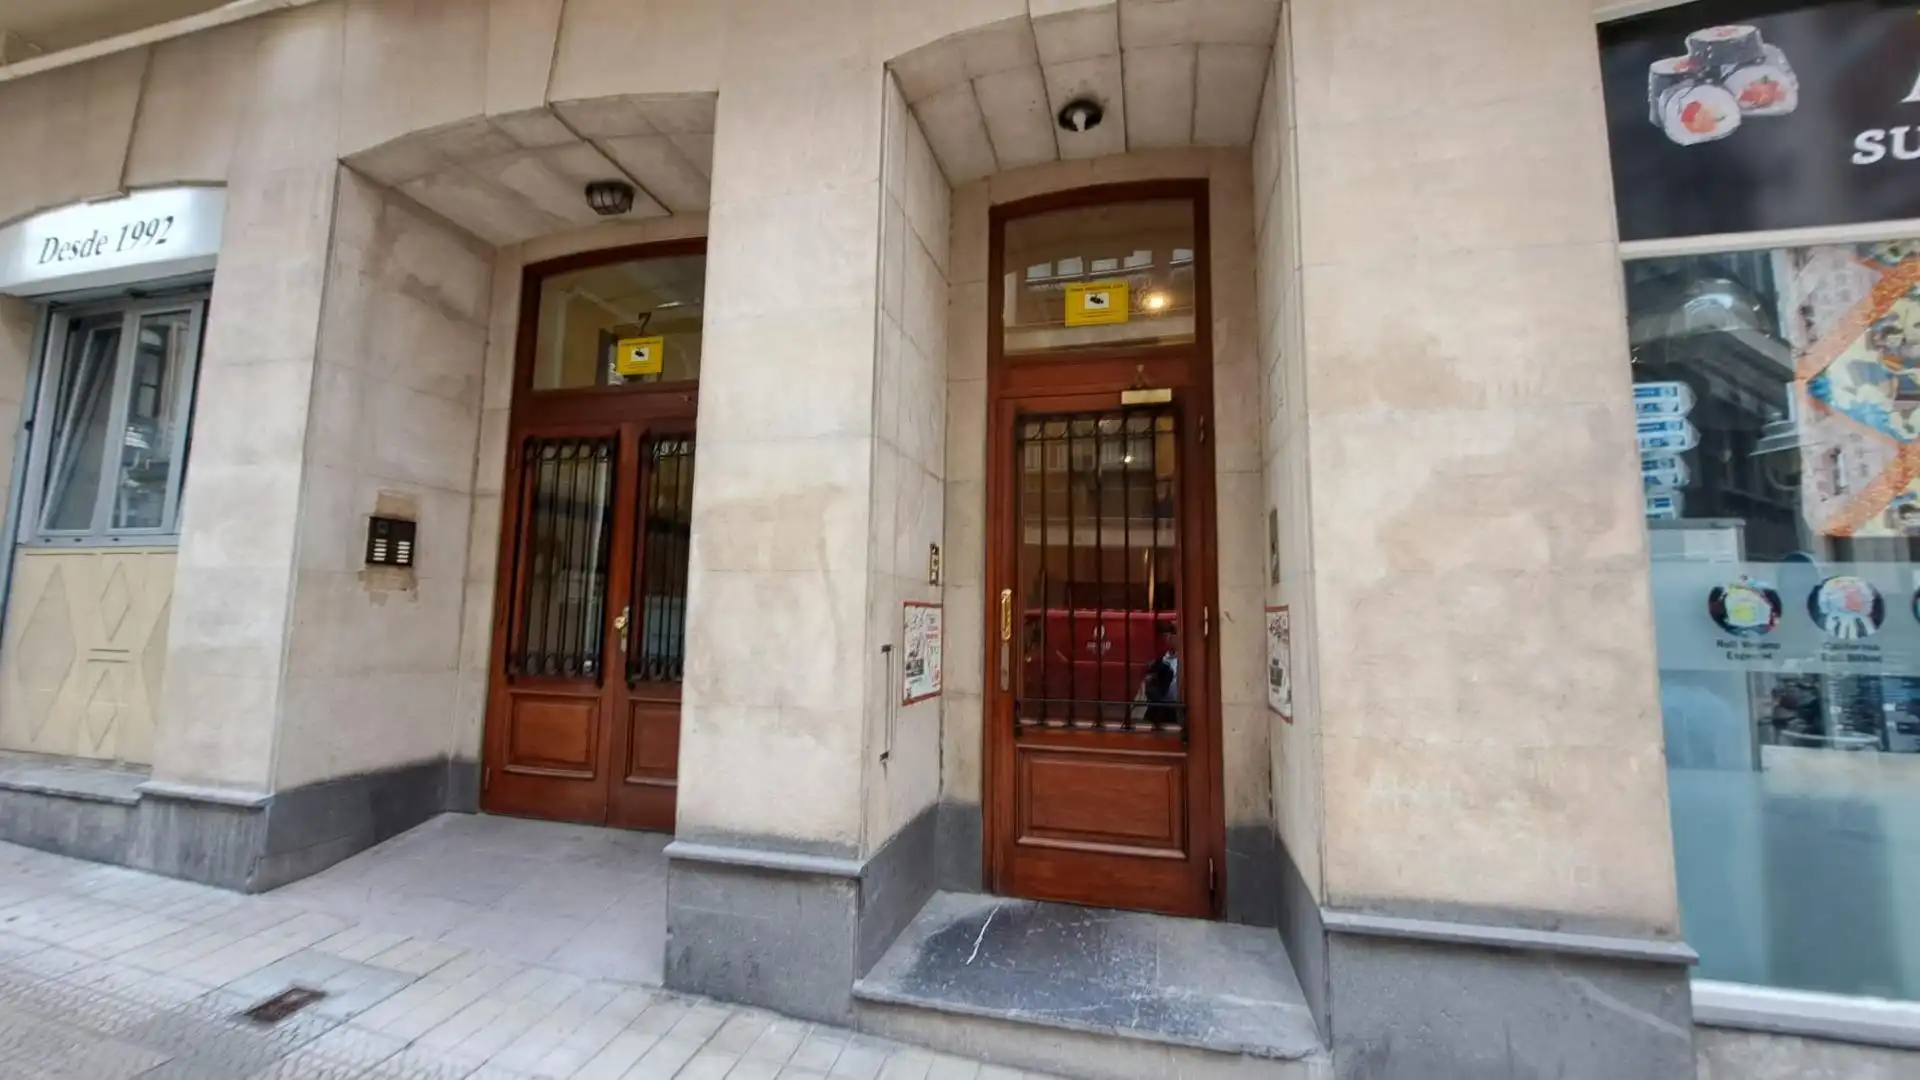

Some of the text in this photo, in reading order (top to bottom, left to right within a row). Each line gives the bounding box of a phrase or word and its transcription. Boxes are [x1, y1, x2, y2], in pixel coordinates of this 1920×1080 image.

[37, 215, 174, 265] Desde 1992
[638, 311, 652, 337] 7
